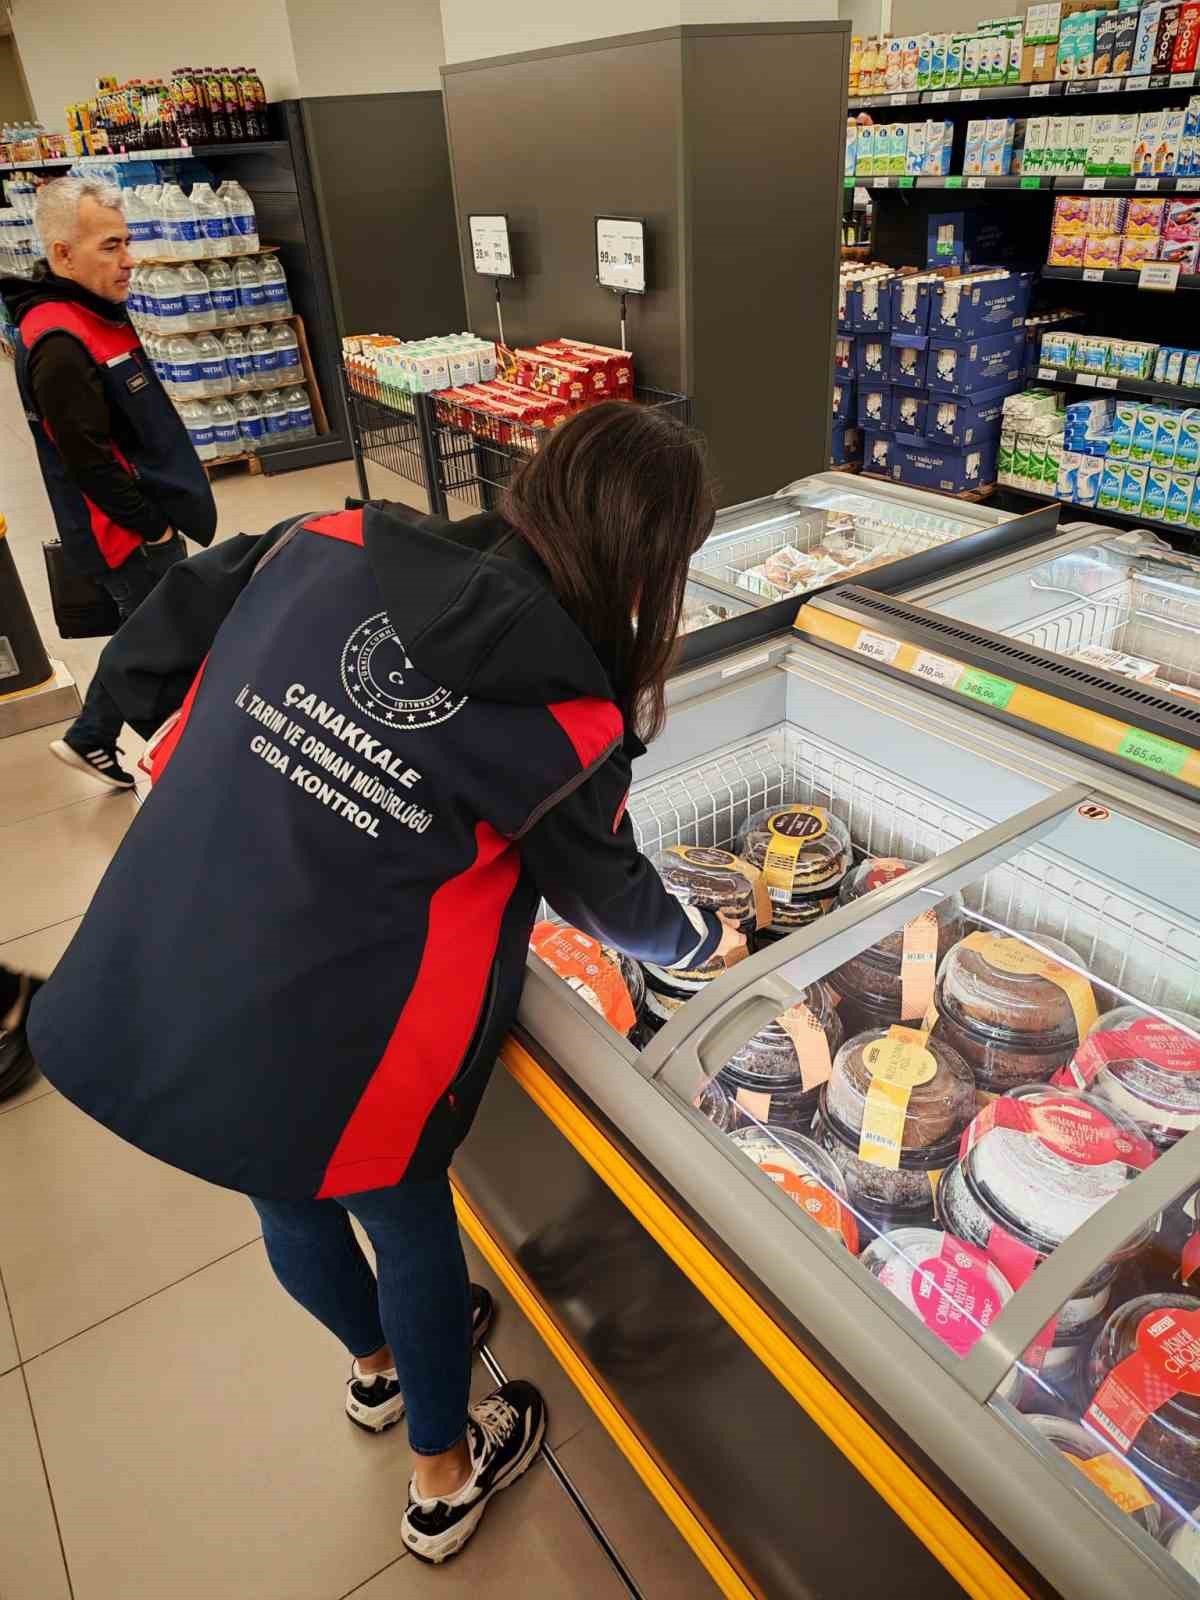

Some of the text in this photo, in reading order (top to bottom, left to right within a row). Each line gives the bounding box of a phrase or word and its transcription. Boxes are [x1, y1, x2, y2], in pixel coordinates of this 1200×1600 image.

[234, 684, 433, 834] İL TARIM VE ORMAN MÜDÜRLÜĞÜ
[250, 735, 382, 839] GIDA KONTROL
[284, 683, 422, 789] ÇANAKKALE
